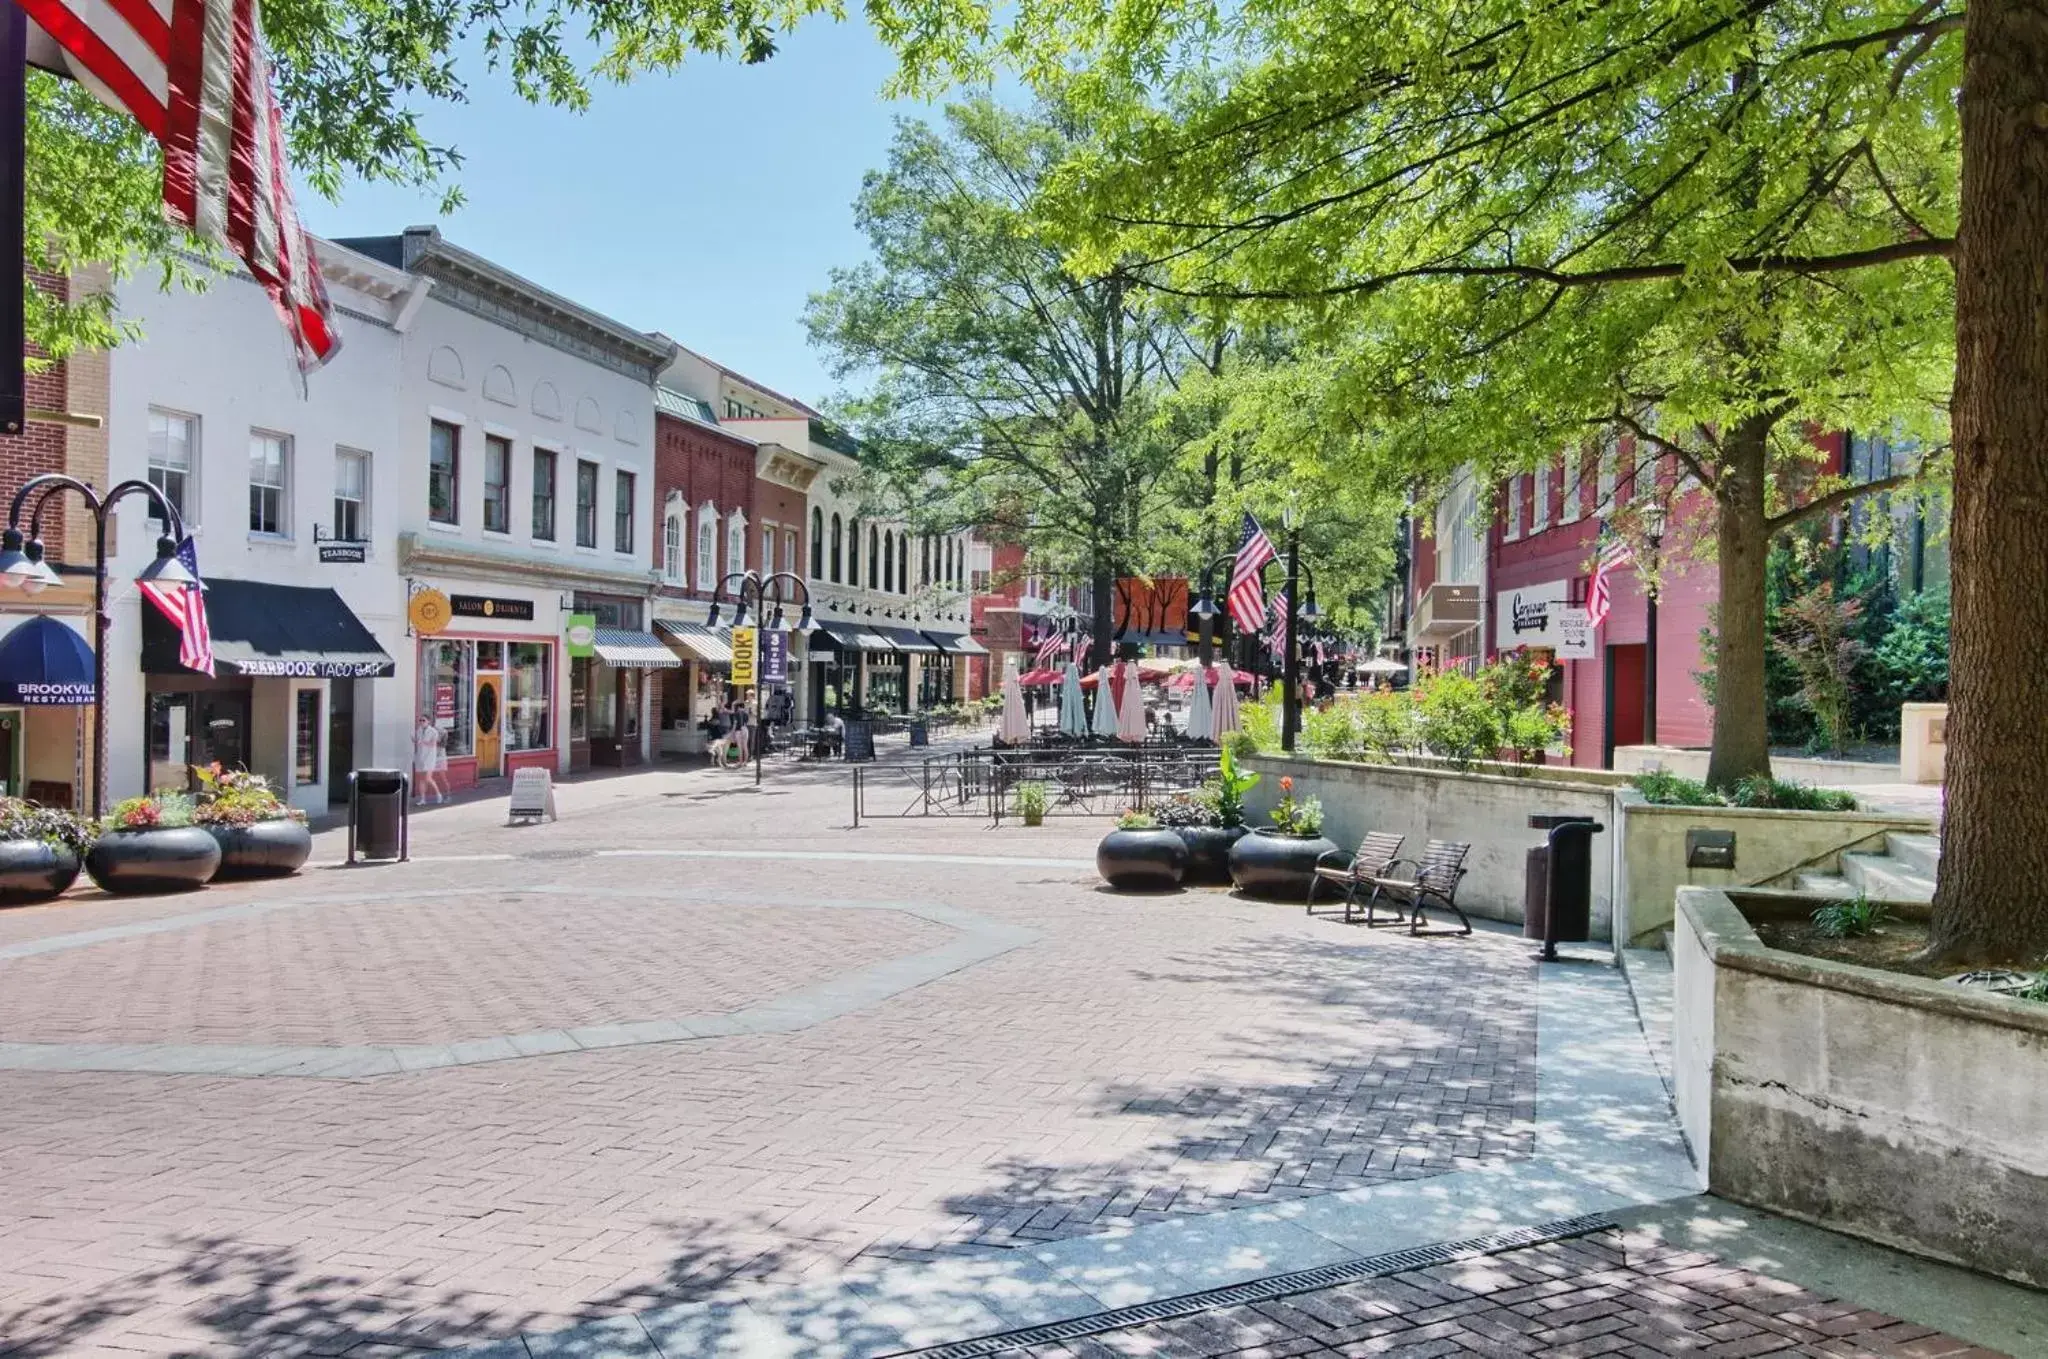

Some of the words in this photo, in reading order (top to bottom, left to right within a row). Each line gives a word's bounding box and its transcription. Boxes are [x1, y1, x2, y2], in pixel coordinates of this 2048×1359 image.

[239, 660, 316, 676] YEARBOOK
[321, 661, 351, 677] TACO
[355, 663, 380, 676] BAR
[18, 683, 96, 694] BROOKVILL
[23, 695, 95, 703] RESTAURAN
